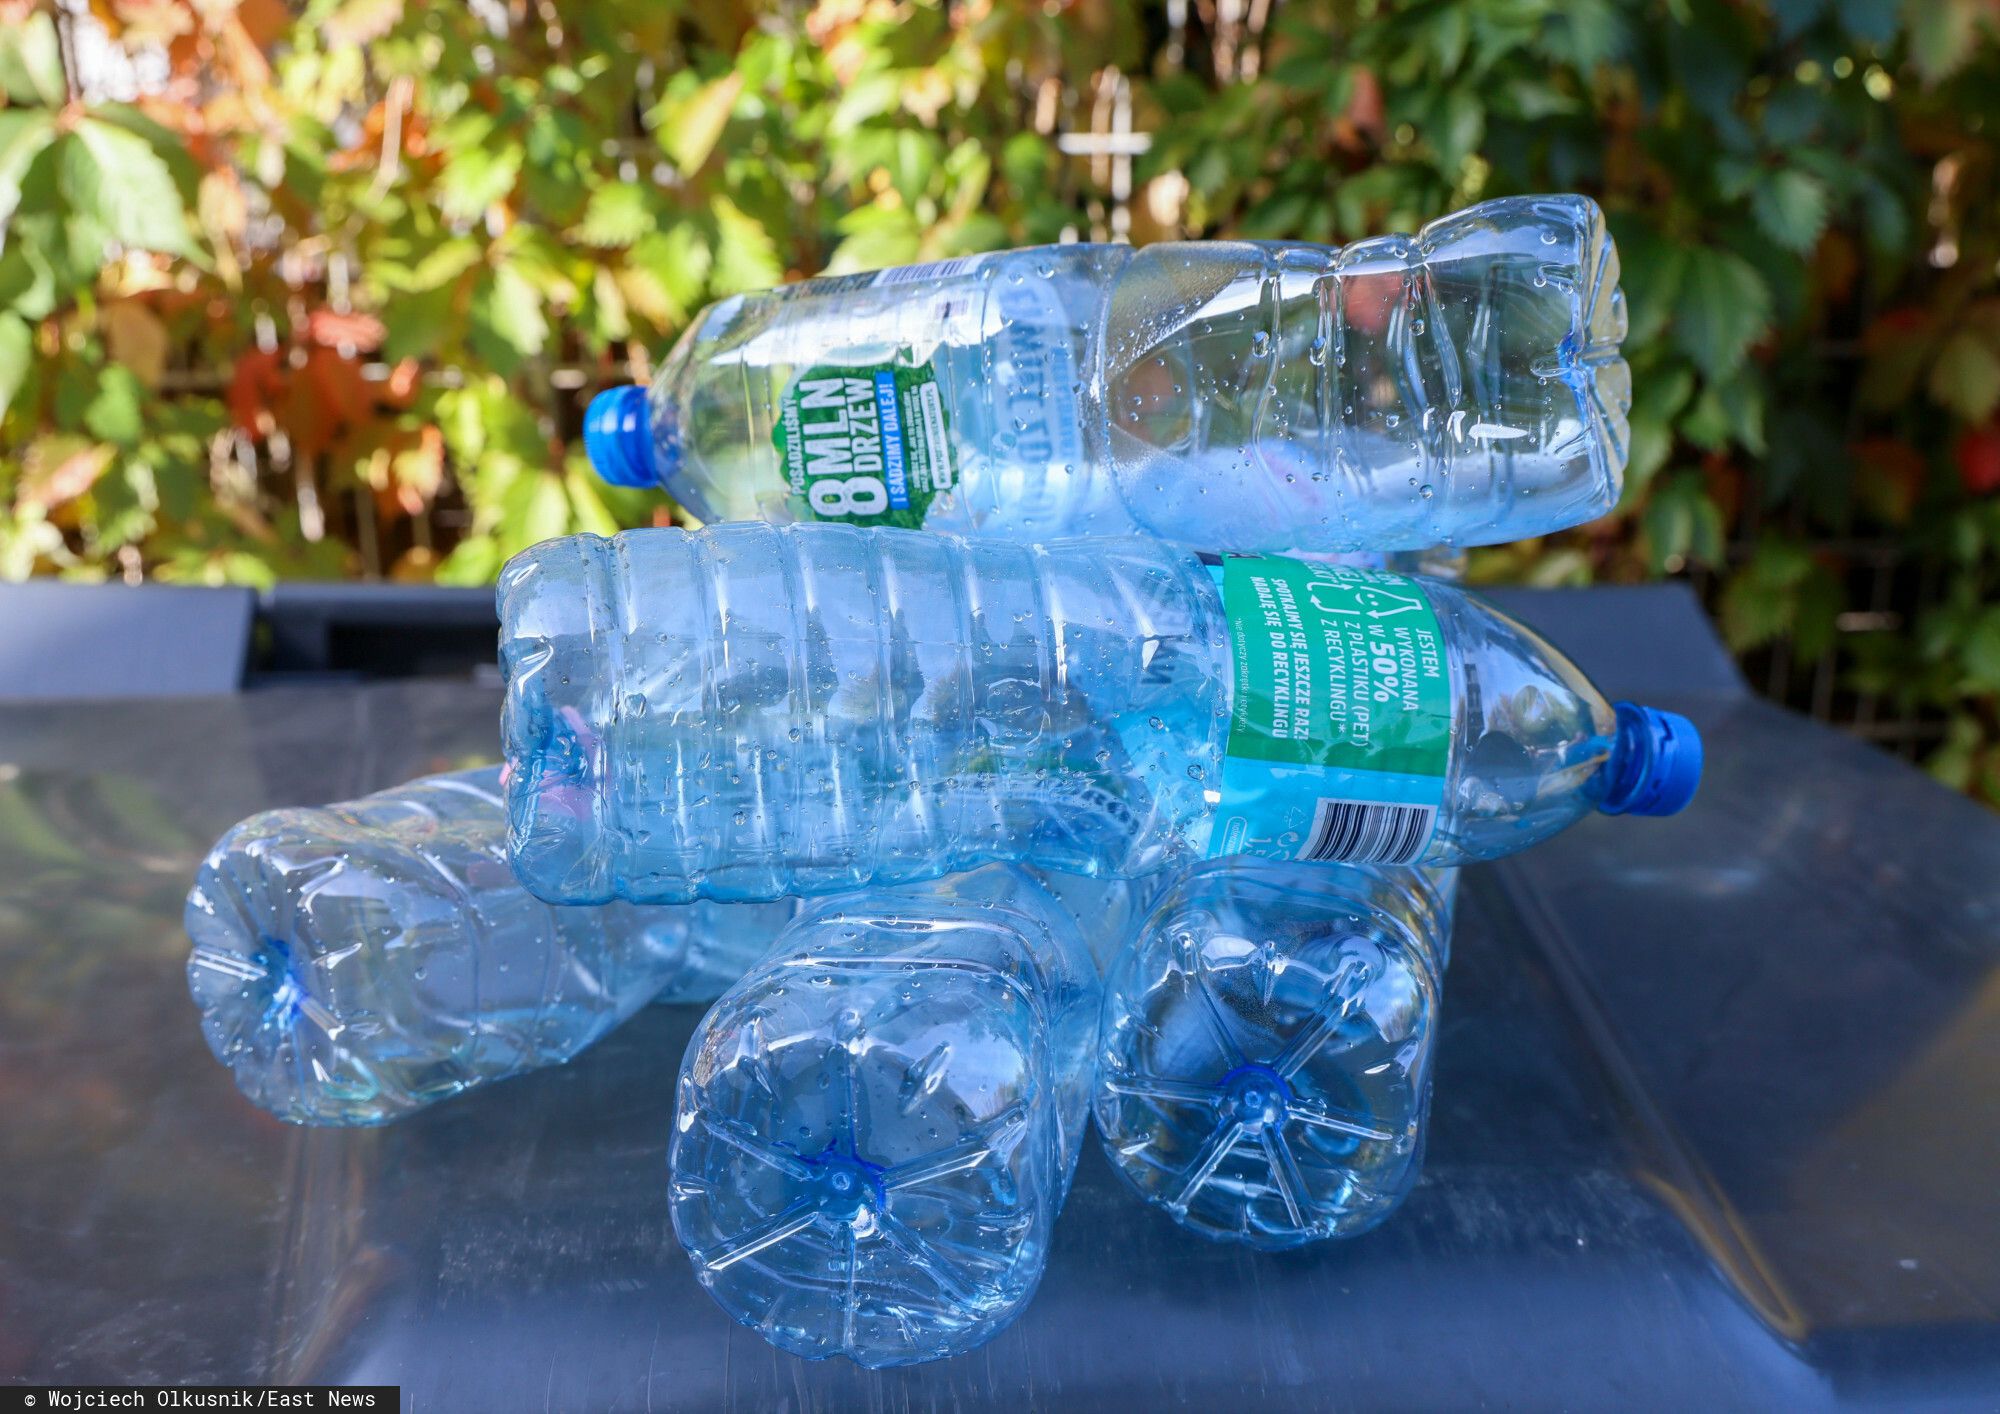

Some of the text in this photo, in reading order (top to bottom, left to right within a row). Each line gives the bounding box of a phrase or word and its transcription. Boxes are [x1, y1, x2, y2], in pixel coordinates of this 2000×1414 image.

[781, 399, 805, 495] POSADZILIŚMY
[799, 378, 888, 516] 8 MLN
[844, 378, 883, 472] DRZEW
[879, 384, 898, 432] DALEJ!
[883, 437, 906, 495] SADZIMY
[1250, 576, 1290, 739] NADAJĘ SIĘ DO RECYKLINGU
[1271, 577, 1311, 740] SPOTKAJMY SIĘ JESZCZE RAZ!
[1320, 618, 1338, 628] Z
[1368, 624, 1400, 702] W 50%
[1416, 628, 1440, 678] JESTEM
[1344, 620, 1371, 747] Z PLASTIKU (PET)
[1393, 626, 1419, 711] WYKONANA
